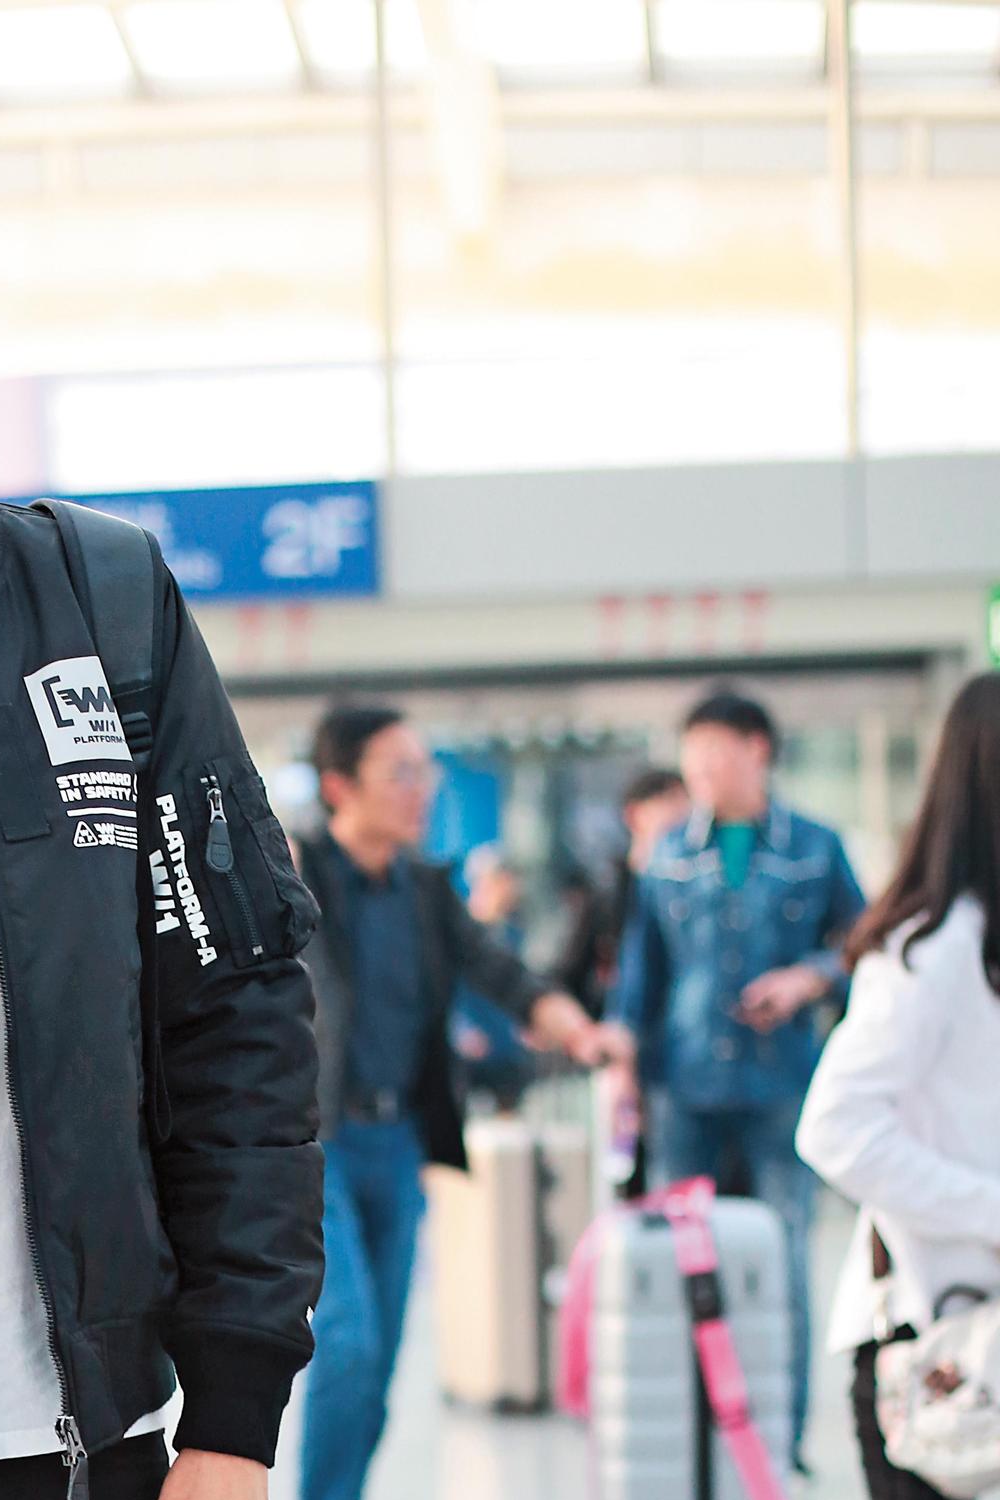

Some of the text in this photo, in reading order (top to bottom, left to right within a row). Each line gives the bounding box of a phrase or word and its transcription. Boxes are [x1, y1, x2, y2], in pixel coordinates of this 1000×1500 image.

[56, 771, 132, 789] STANDARD
[60, 787, 82, 802] IN
[84, 785, 132, 801] SAFETY
[156, 793, 218, 967] PLATFORM-A
